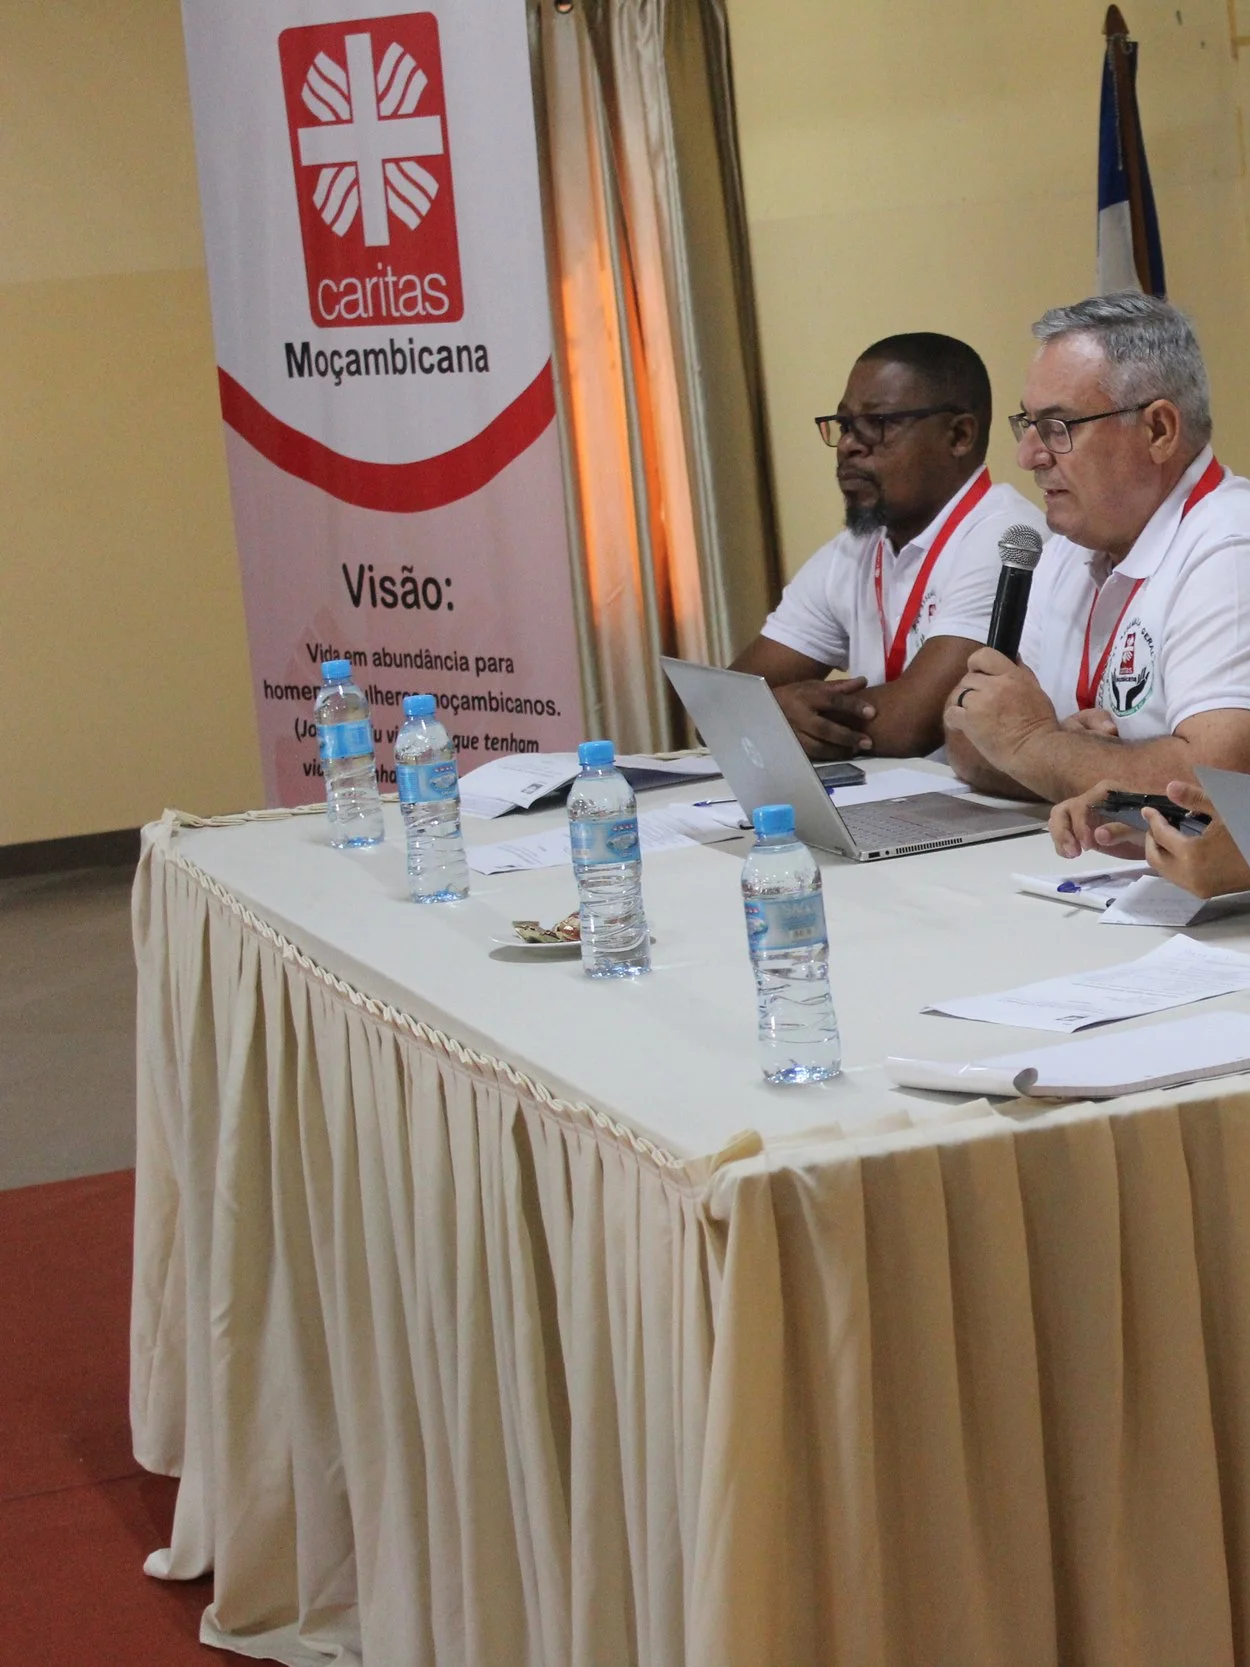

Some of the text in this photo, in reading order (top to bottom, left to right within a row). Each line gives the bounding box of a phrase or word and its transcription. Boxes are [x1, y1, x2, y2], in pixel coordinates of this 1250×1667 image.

[317, 262, 450, 321] caritas
[284, 337, 491, 387] Moçambicana
[342, 563, 454, 611] Visão:
[306, 642, 341, 663] Vida
[372, 647, 470, 672] abundância
[474, 655, 515, 678] para
[452, 734, 479, 753] que
[484, 732, 540, 753] tenham
